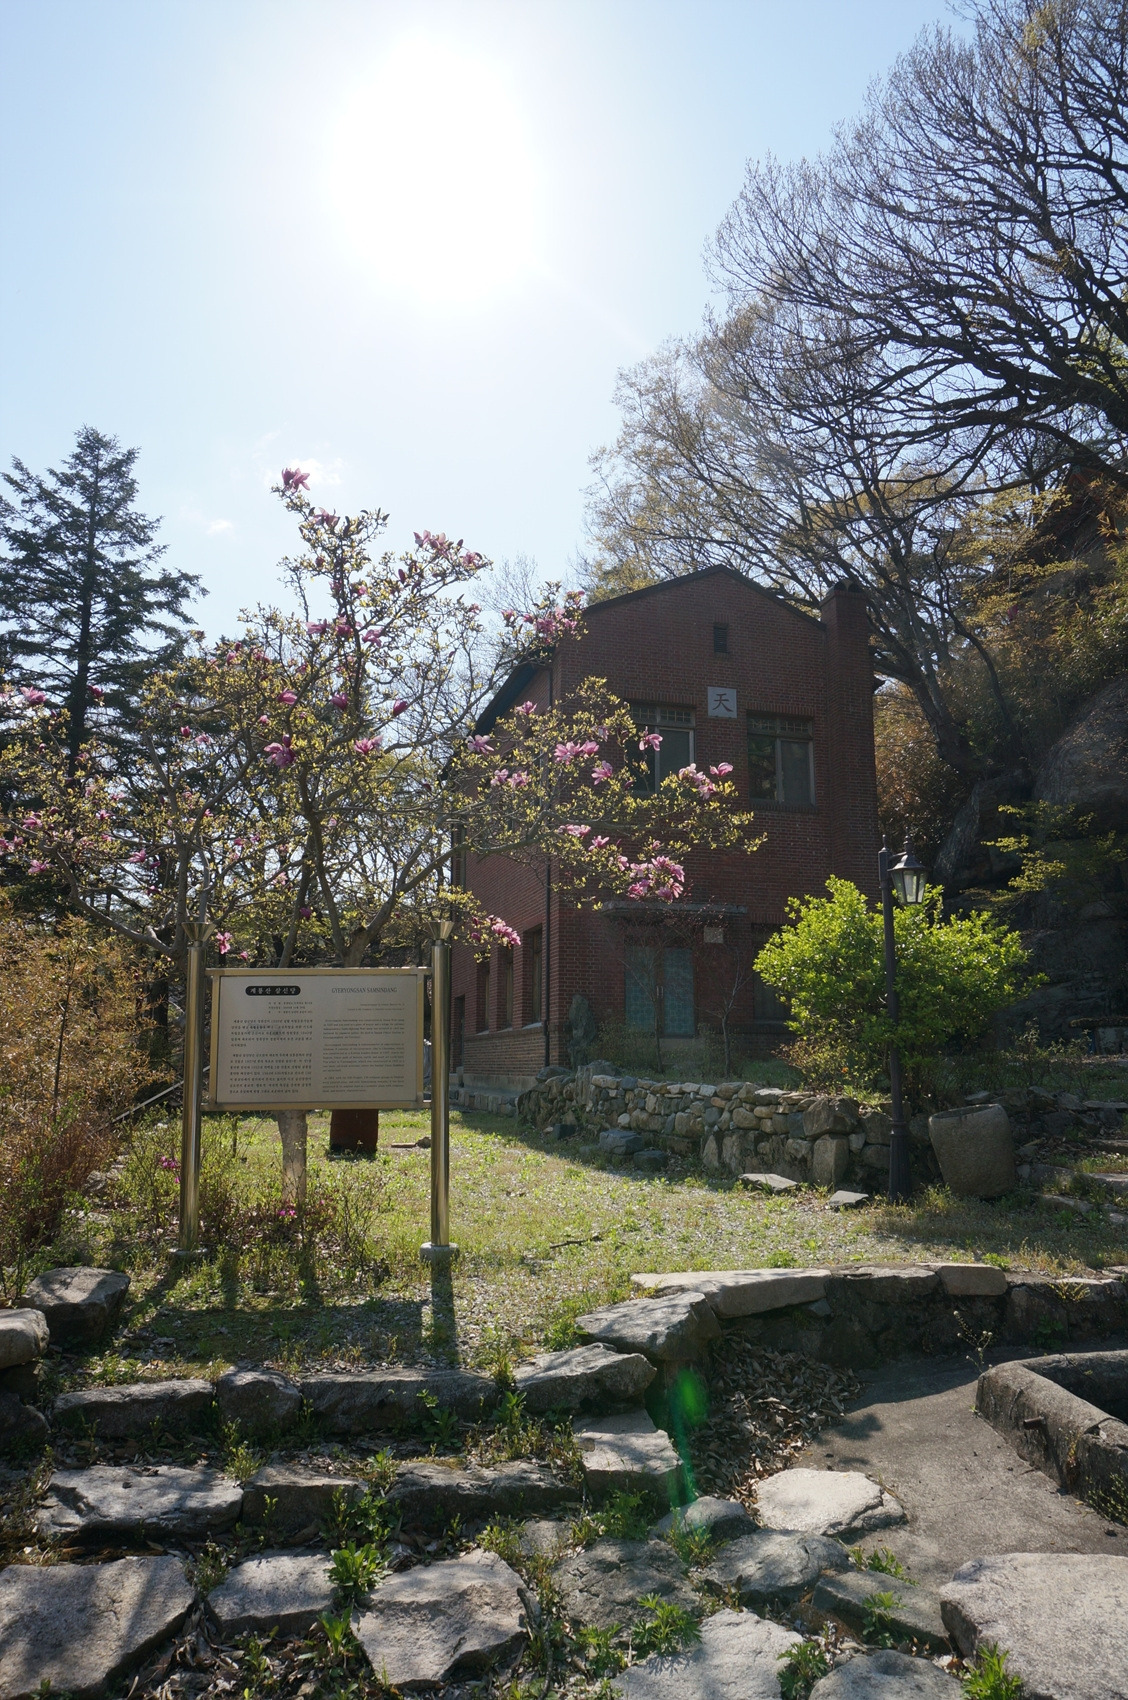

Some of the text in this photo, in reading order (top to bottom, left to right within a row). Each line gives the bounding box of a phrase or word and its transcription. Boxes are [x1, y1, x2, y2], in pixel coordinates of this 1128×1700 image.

[711, 693, 734, 713] 天
[250, 987, 296, 995] 계룡산 삼신당
